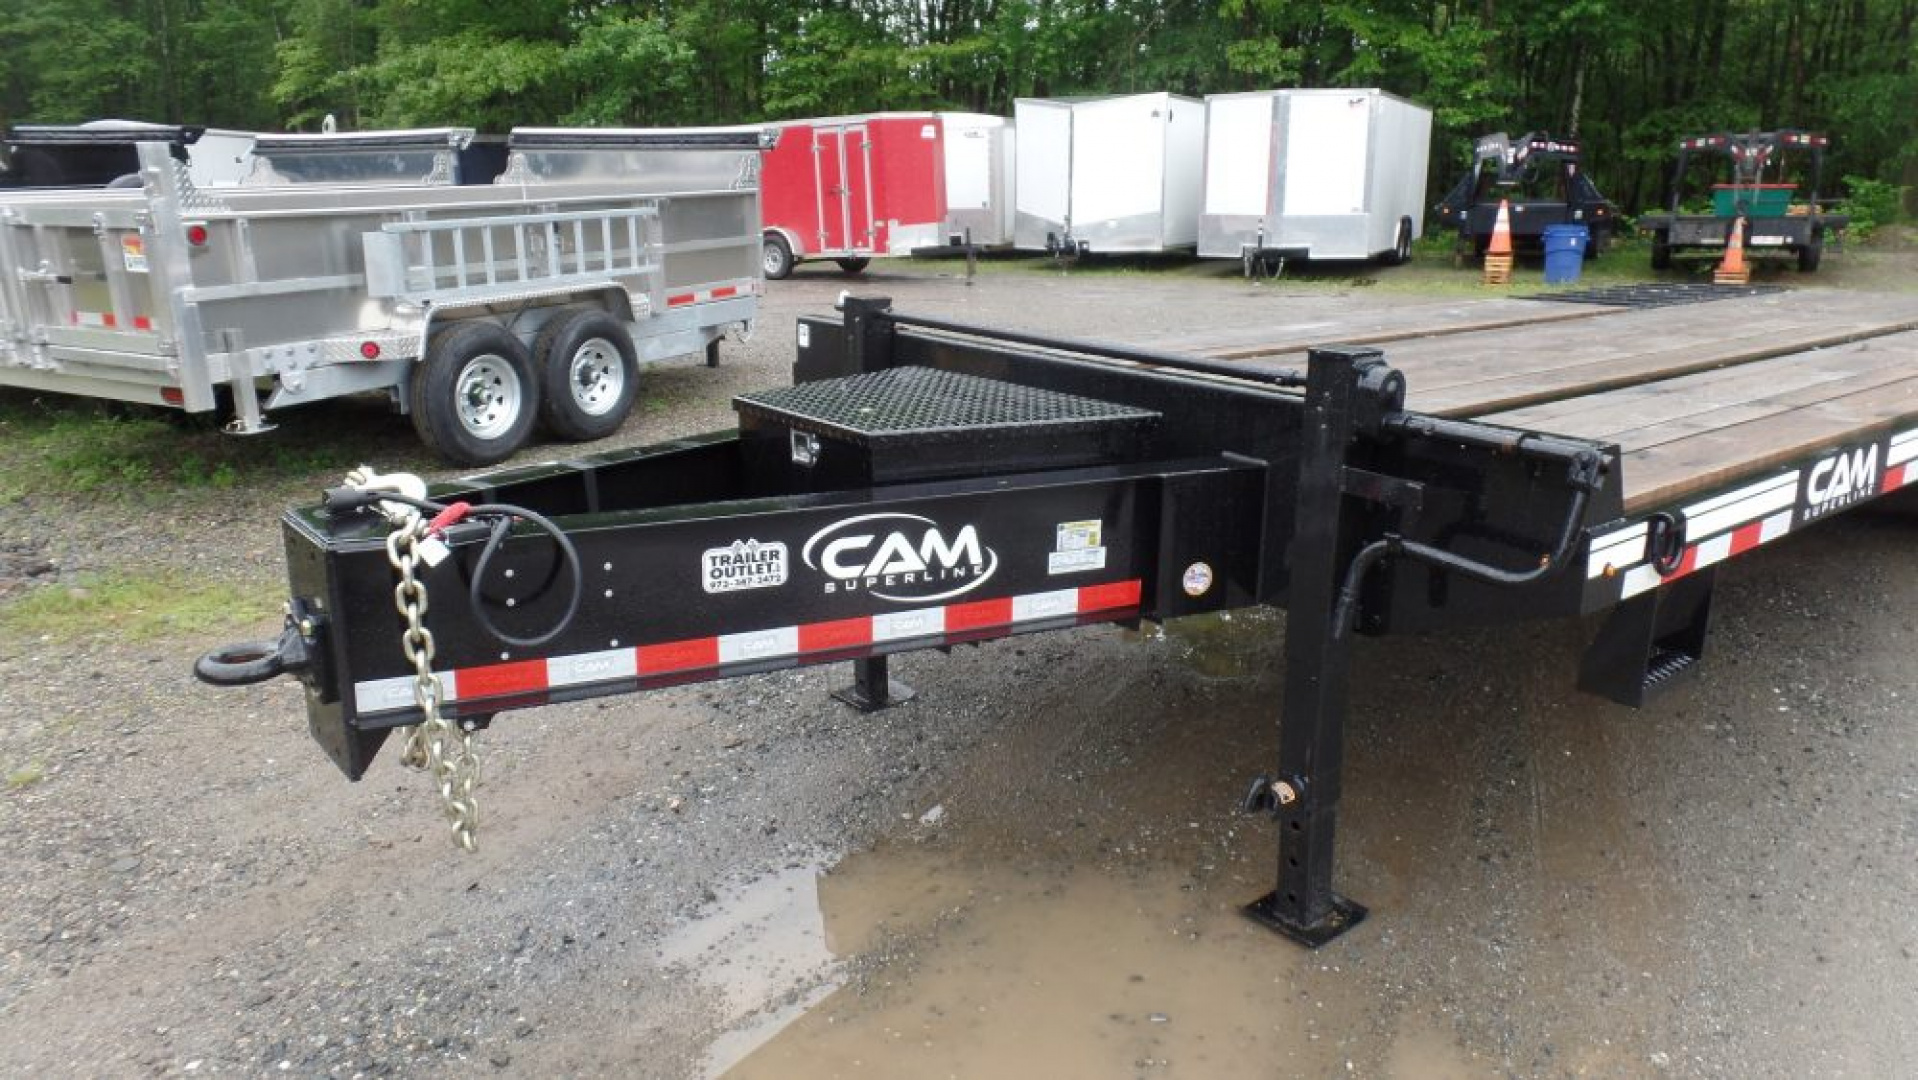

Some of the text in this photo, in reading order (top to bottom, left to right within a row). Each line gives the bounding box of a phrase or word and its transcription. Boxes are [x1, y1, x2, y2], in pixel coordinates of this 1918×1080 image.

[1808, 442, 1878, 505] CAM
[709, 550, 780, 566] TRAILER
[821, 524, 982, 579] CAM
[709, 562, 773, 579] OUTLET
[824, 564, 983, 593] SUPERLINE
